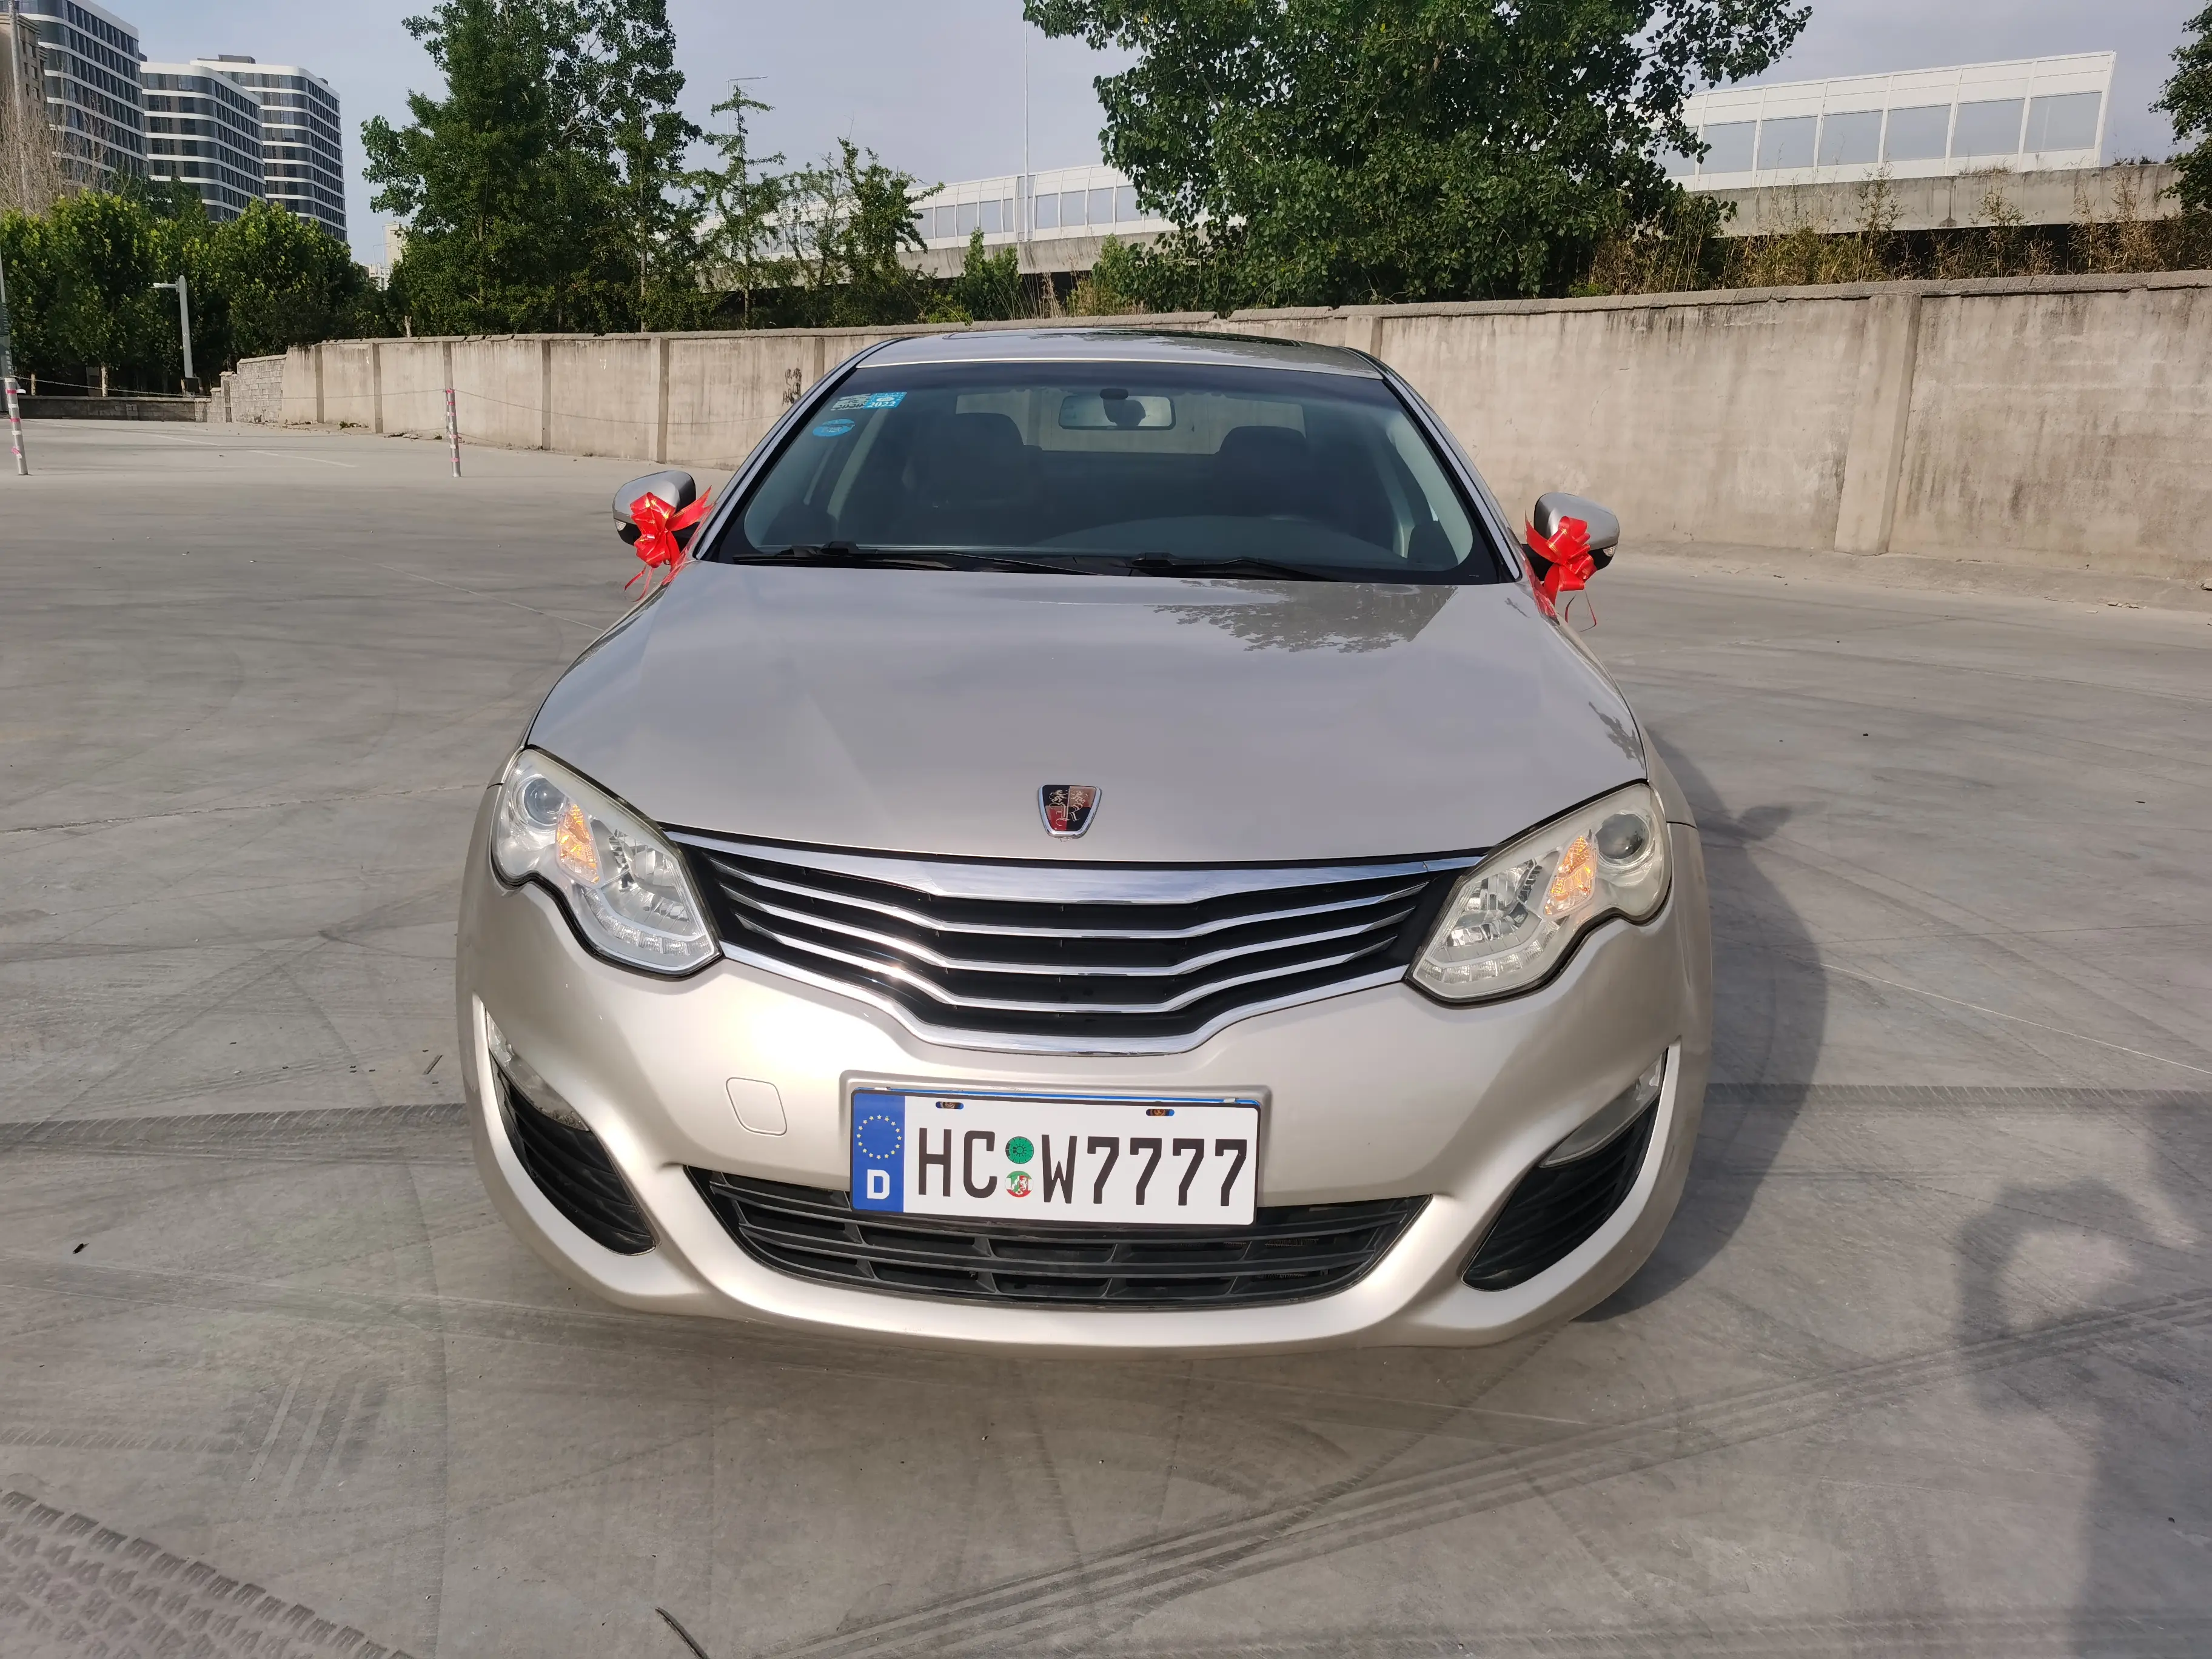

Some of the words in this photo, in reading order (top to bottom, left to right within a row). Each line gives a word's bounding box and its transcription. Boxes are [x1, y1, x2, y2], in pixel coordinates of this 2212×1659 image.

[866, 1168, 890, 1199] D
[918, 1127, 997, 1199] HC
[1041, 1134, 1247, 1207] W7777
